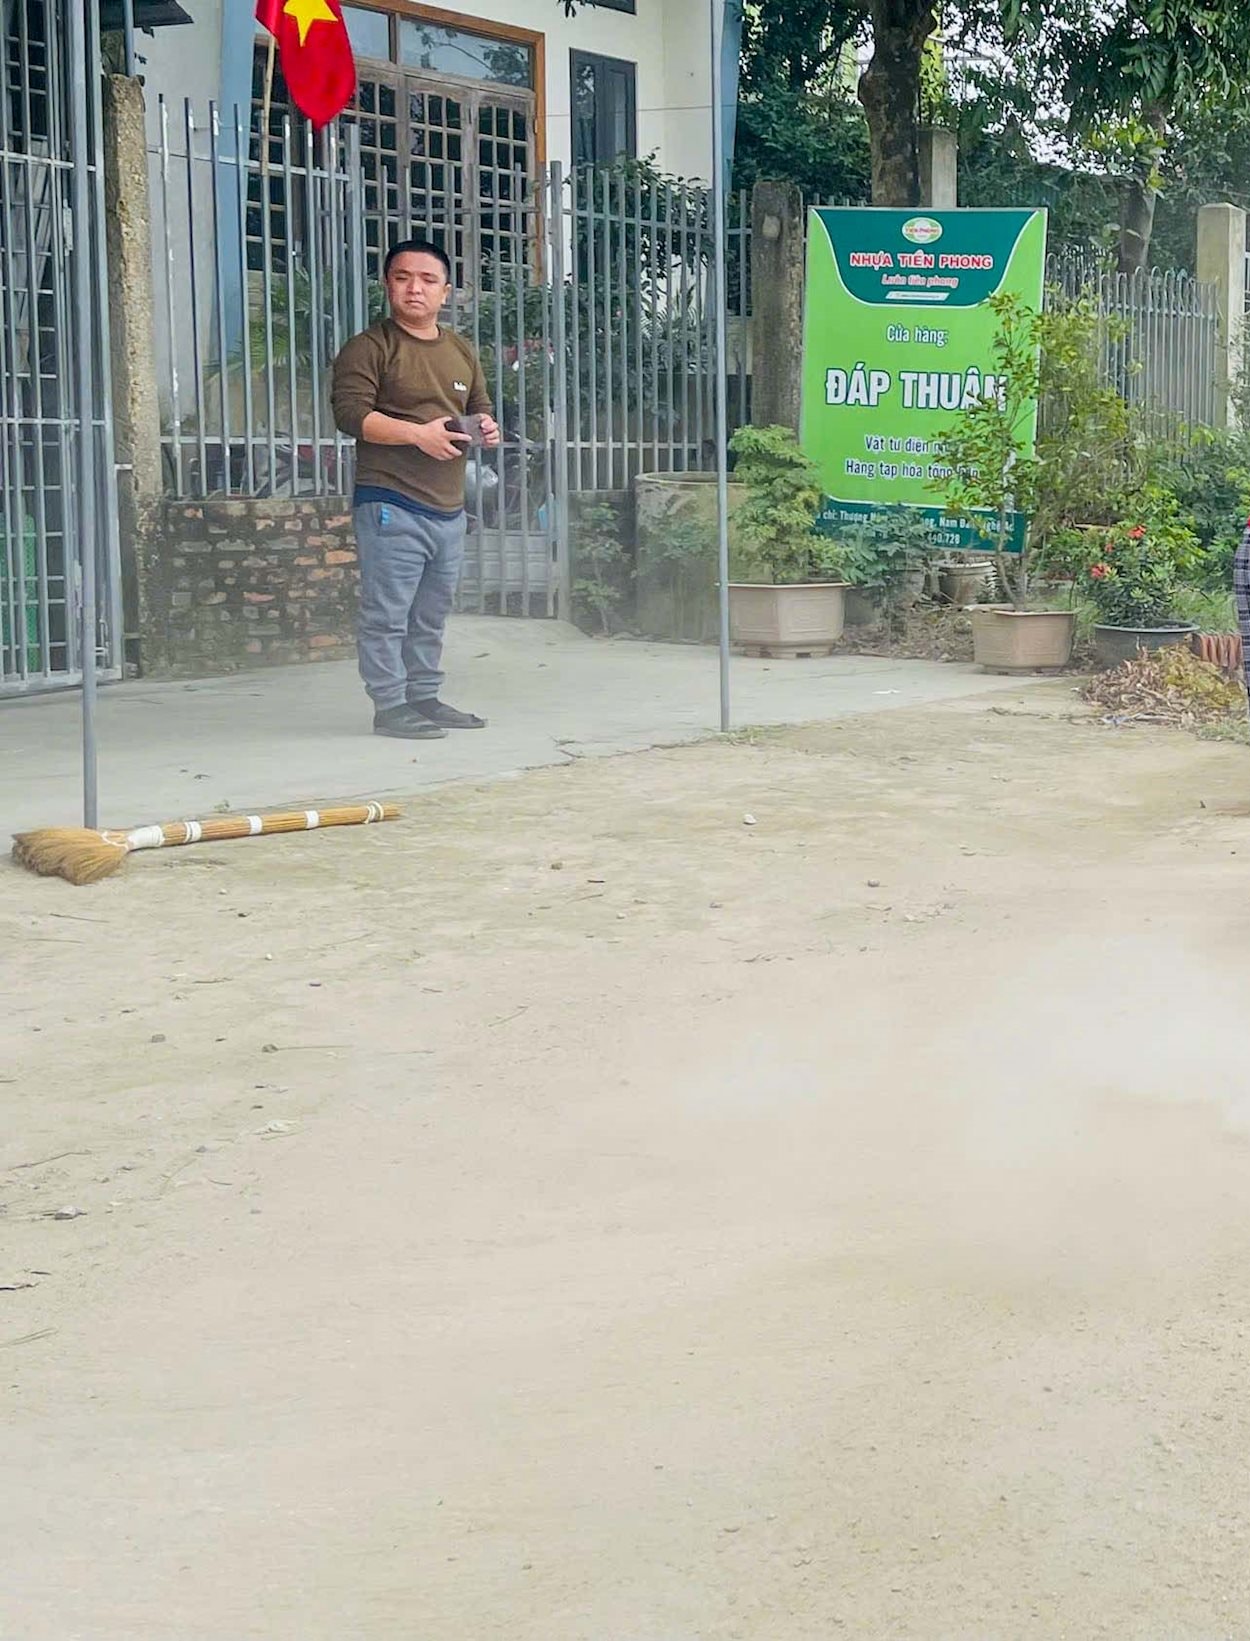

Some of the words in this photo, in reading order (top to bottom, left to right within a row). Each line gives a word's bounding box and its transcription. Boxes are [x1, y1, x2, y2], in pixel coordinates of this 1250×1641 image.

[850, 251, 893, 270] NHỰA
[939, 254, 993, 269] PHONG
[887, 323, 910, 341] Cửa
[826, 363, 890, 405] ĐÁP
[940, 517, 957, 528] Nam
